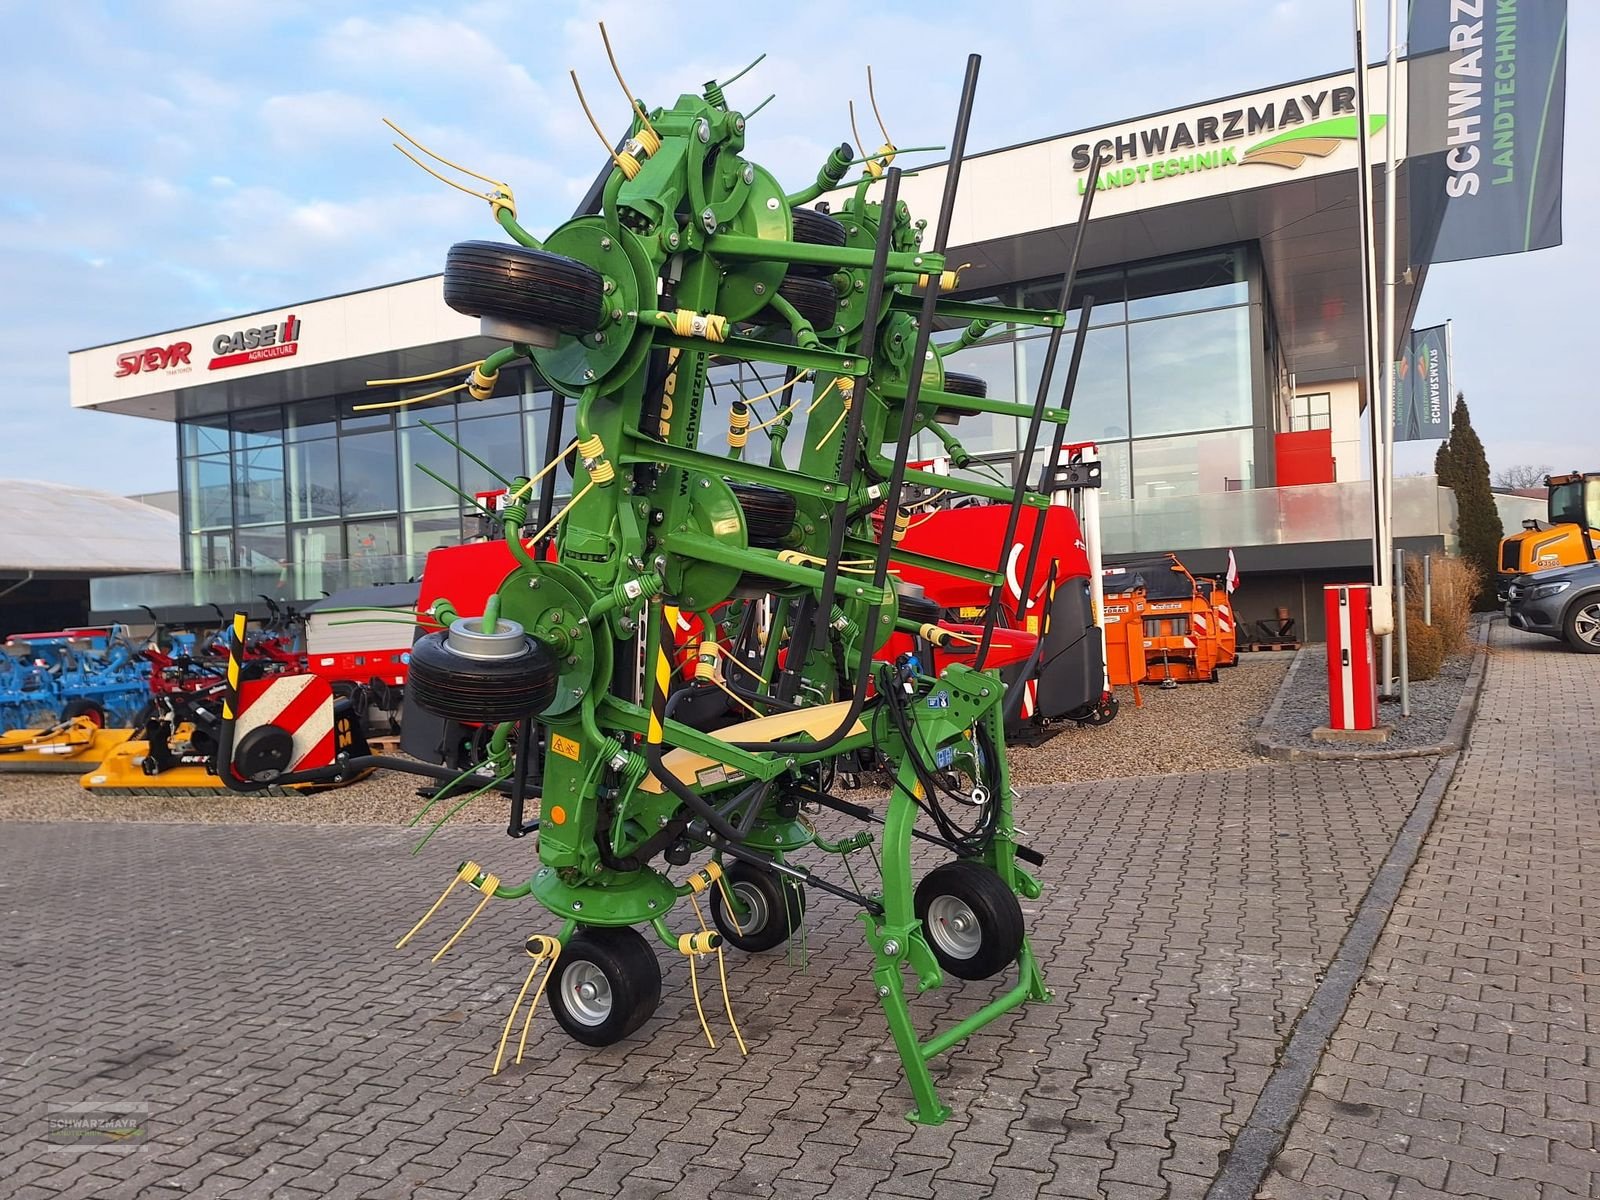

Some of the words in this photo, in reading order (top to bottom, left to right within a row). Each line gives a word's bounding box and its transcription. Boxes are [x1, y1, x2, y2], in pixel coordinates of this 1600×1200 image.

[1492, 0, 1518, 185] LANDTECHNIK
[1071, 86, 1355, 173] SCHWARZMAYR
[212, 324, 277, 355] CASE
[248, 345, 294, 361] AGRICULTURE
[114, 341, 192, 378] STEYR
